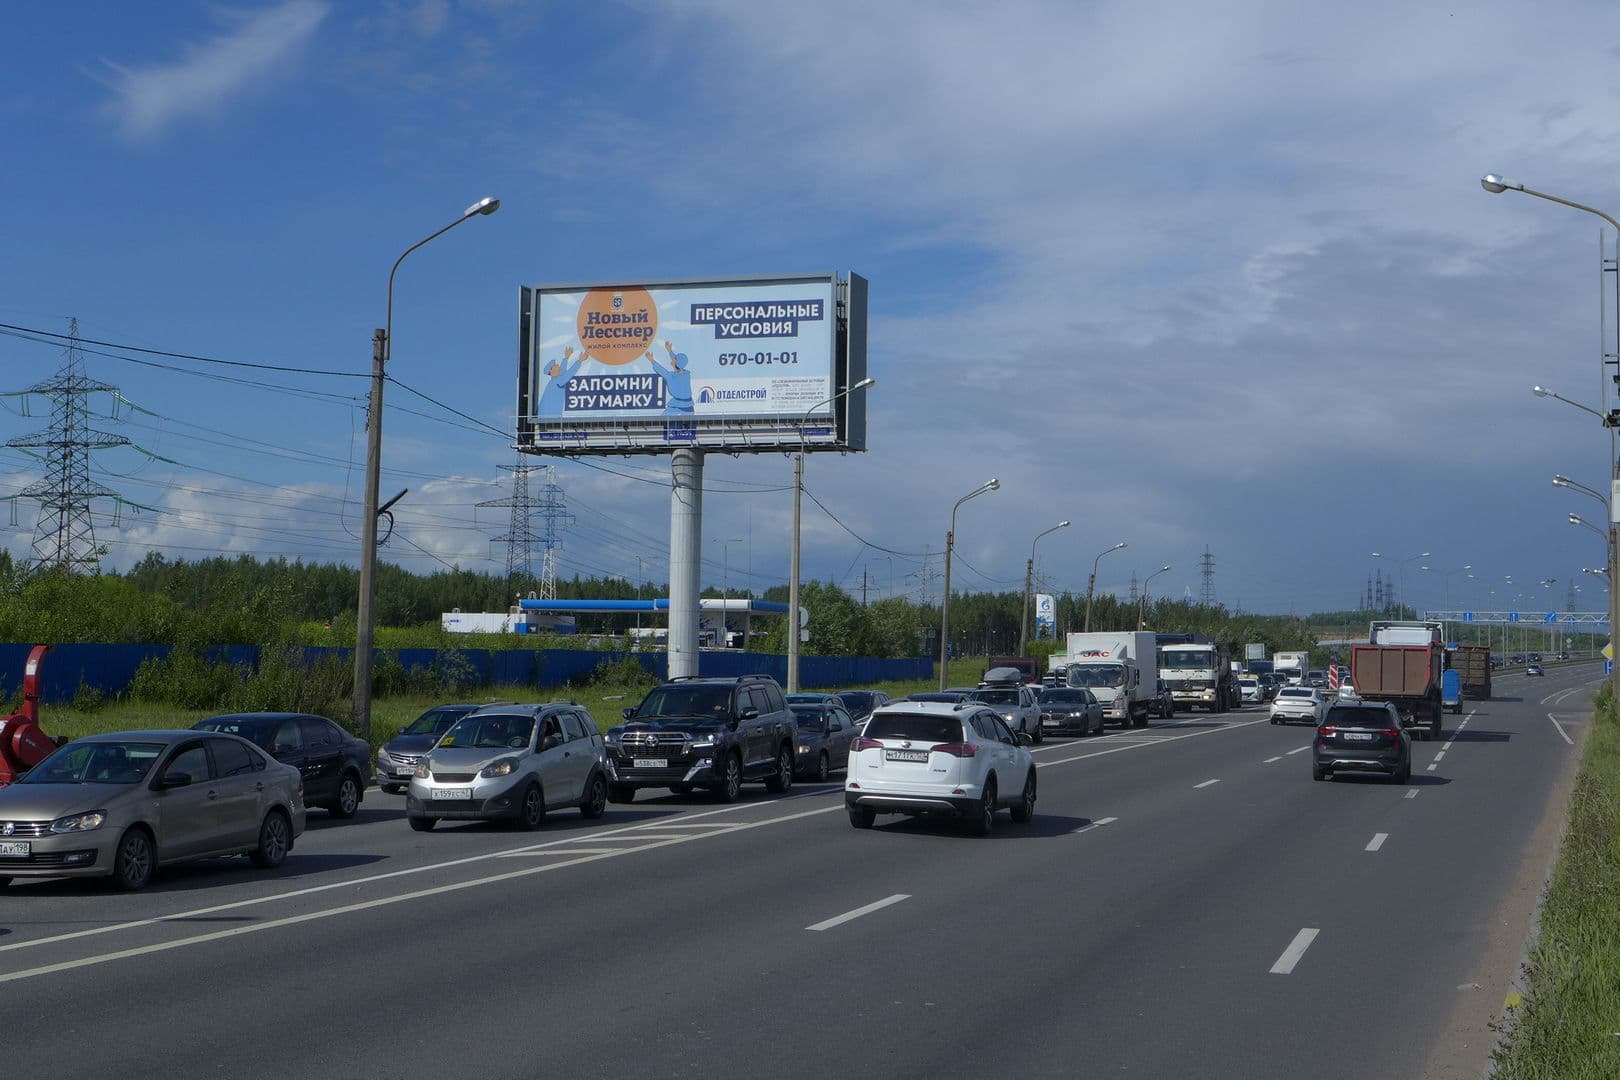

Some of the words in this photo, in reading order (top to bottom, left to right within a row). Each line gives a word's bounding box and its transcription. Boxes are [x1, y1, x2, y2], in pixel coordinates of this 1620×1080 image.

[586, 309, 649, 325] Новый
[695, 304, 819, 321] ПЕРСОНАЛЬНЫЕ
[582, 325, 654, 341] Лесснер
[720, 321, 793, 336] УСЛОВИЯ
[718, 351, 799, 366] 670-01-01
[568, 395, 597, 408] ЭТУ
[716, 388, 767, 400] ОТДЕЛСТРОЙ
